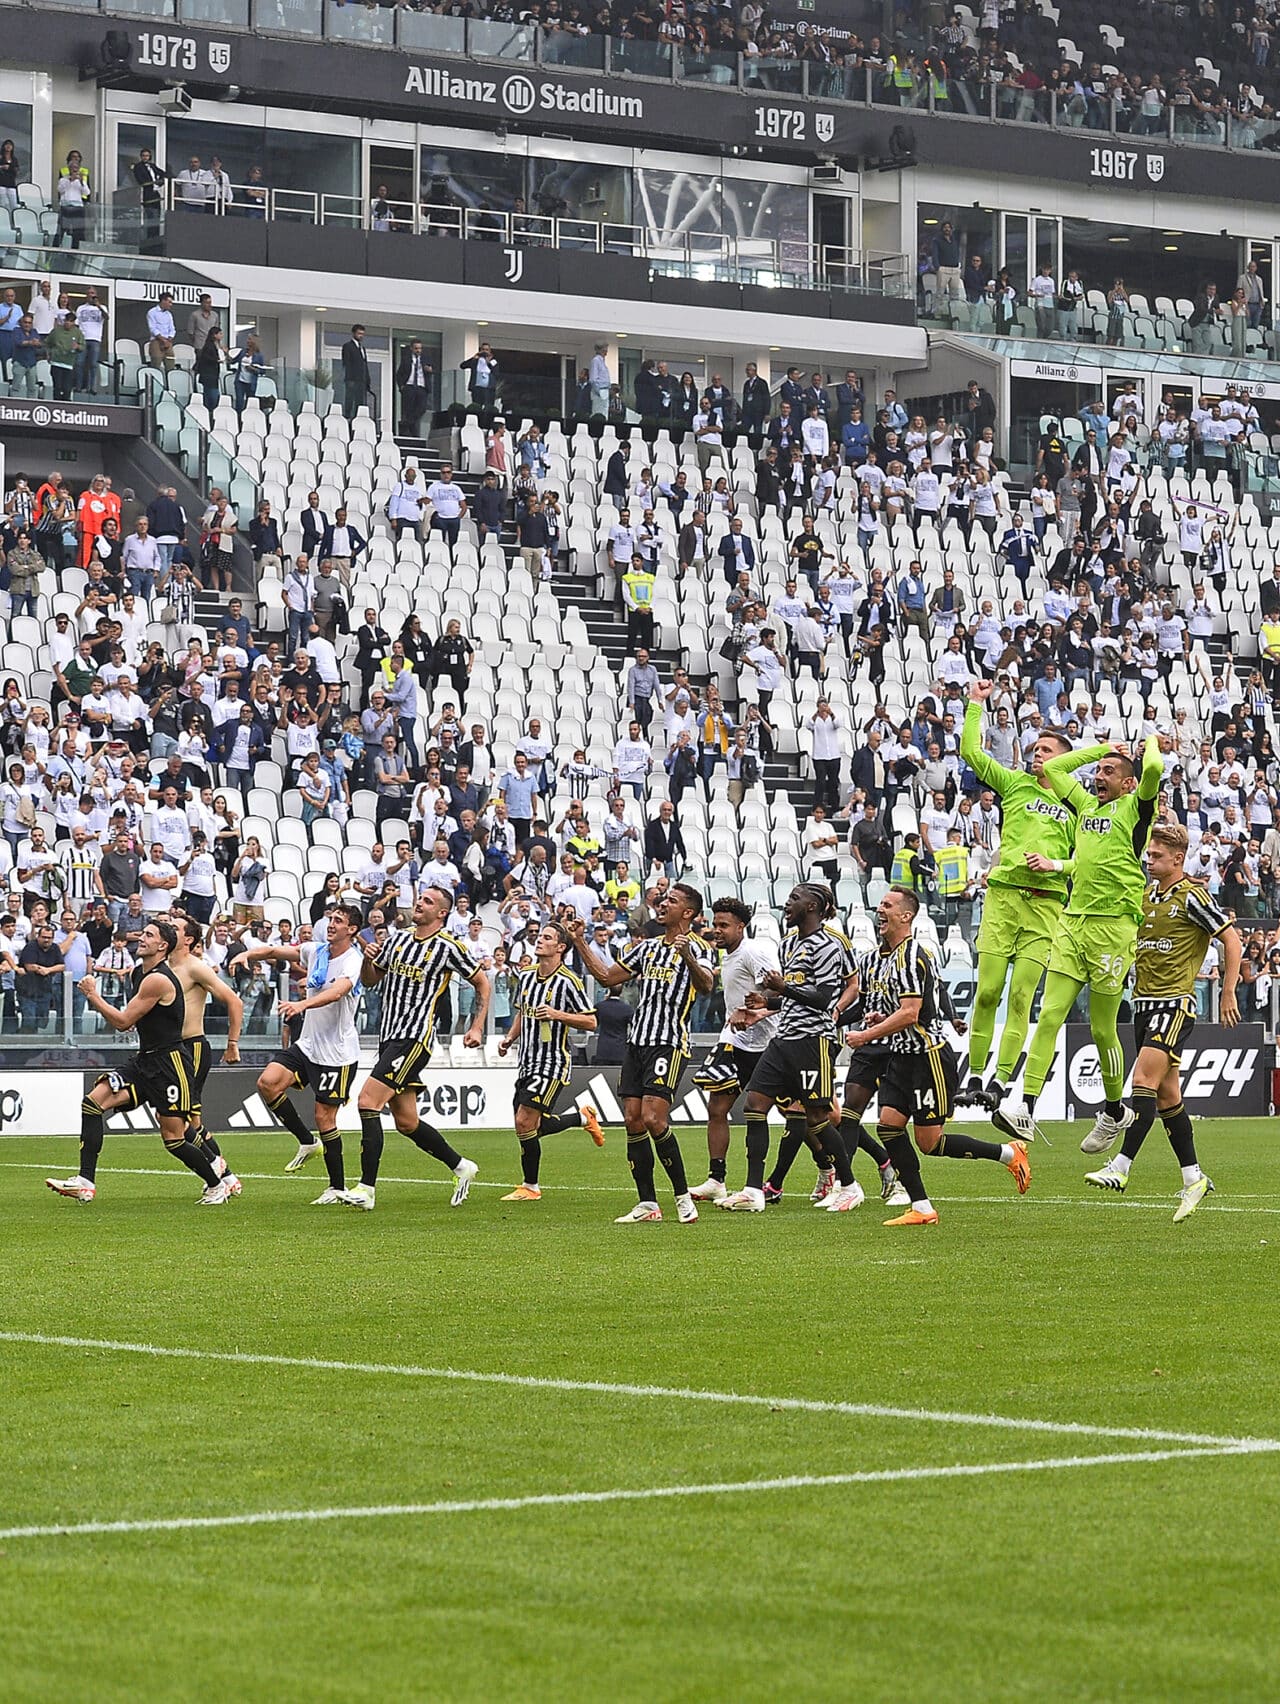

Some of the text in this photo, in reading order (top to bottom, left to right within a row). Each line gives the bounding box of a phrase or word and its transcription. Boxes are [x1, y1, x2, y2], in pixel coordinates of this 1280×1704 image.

[138, 33, 228, 70] 1973 15
[404, 66, 643, 118] Allianz Stadium
[755, 107, 832, 140] 1972 14
[1090, 148, 1163, 180] 1967 13
[143, 283, 203, 303] JUVENTUS
[1035, 365, 1065, 378] Allianz
[52, 409, 109, 427] Stadium
[1026, 799, 1068, 821] Jeep
[1081, 814, 1112, 834] Jeep
[390, 958, 425, 984] Jeep
[1099, 954, 1124, 978] 36
[1149, 1013, 1170, 1033] 41
[391, 1055, 405, 1073] 4
[654, 1056, 669, 1076] 6
[1183, 1049, 1260, 1098] 24
[319, 1071, 339, 1091] 27
[527, 1074, 549, 1096] 21
[800, 1070, 819, 1090] 17
[1076, 1079, 1103, 1087] SPORT
[167, 1084, 179, 1103] 9
[914, 1088, 935, 1110] 14
